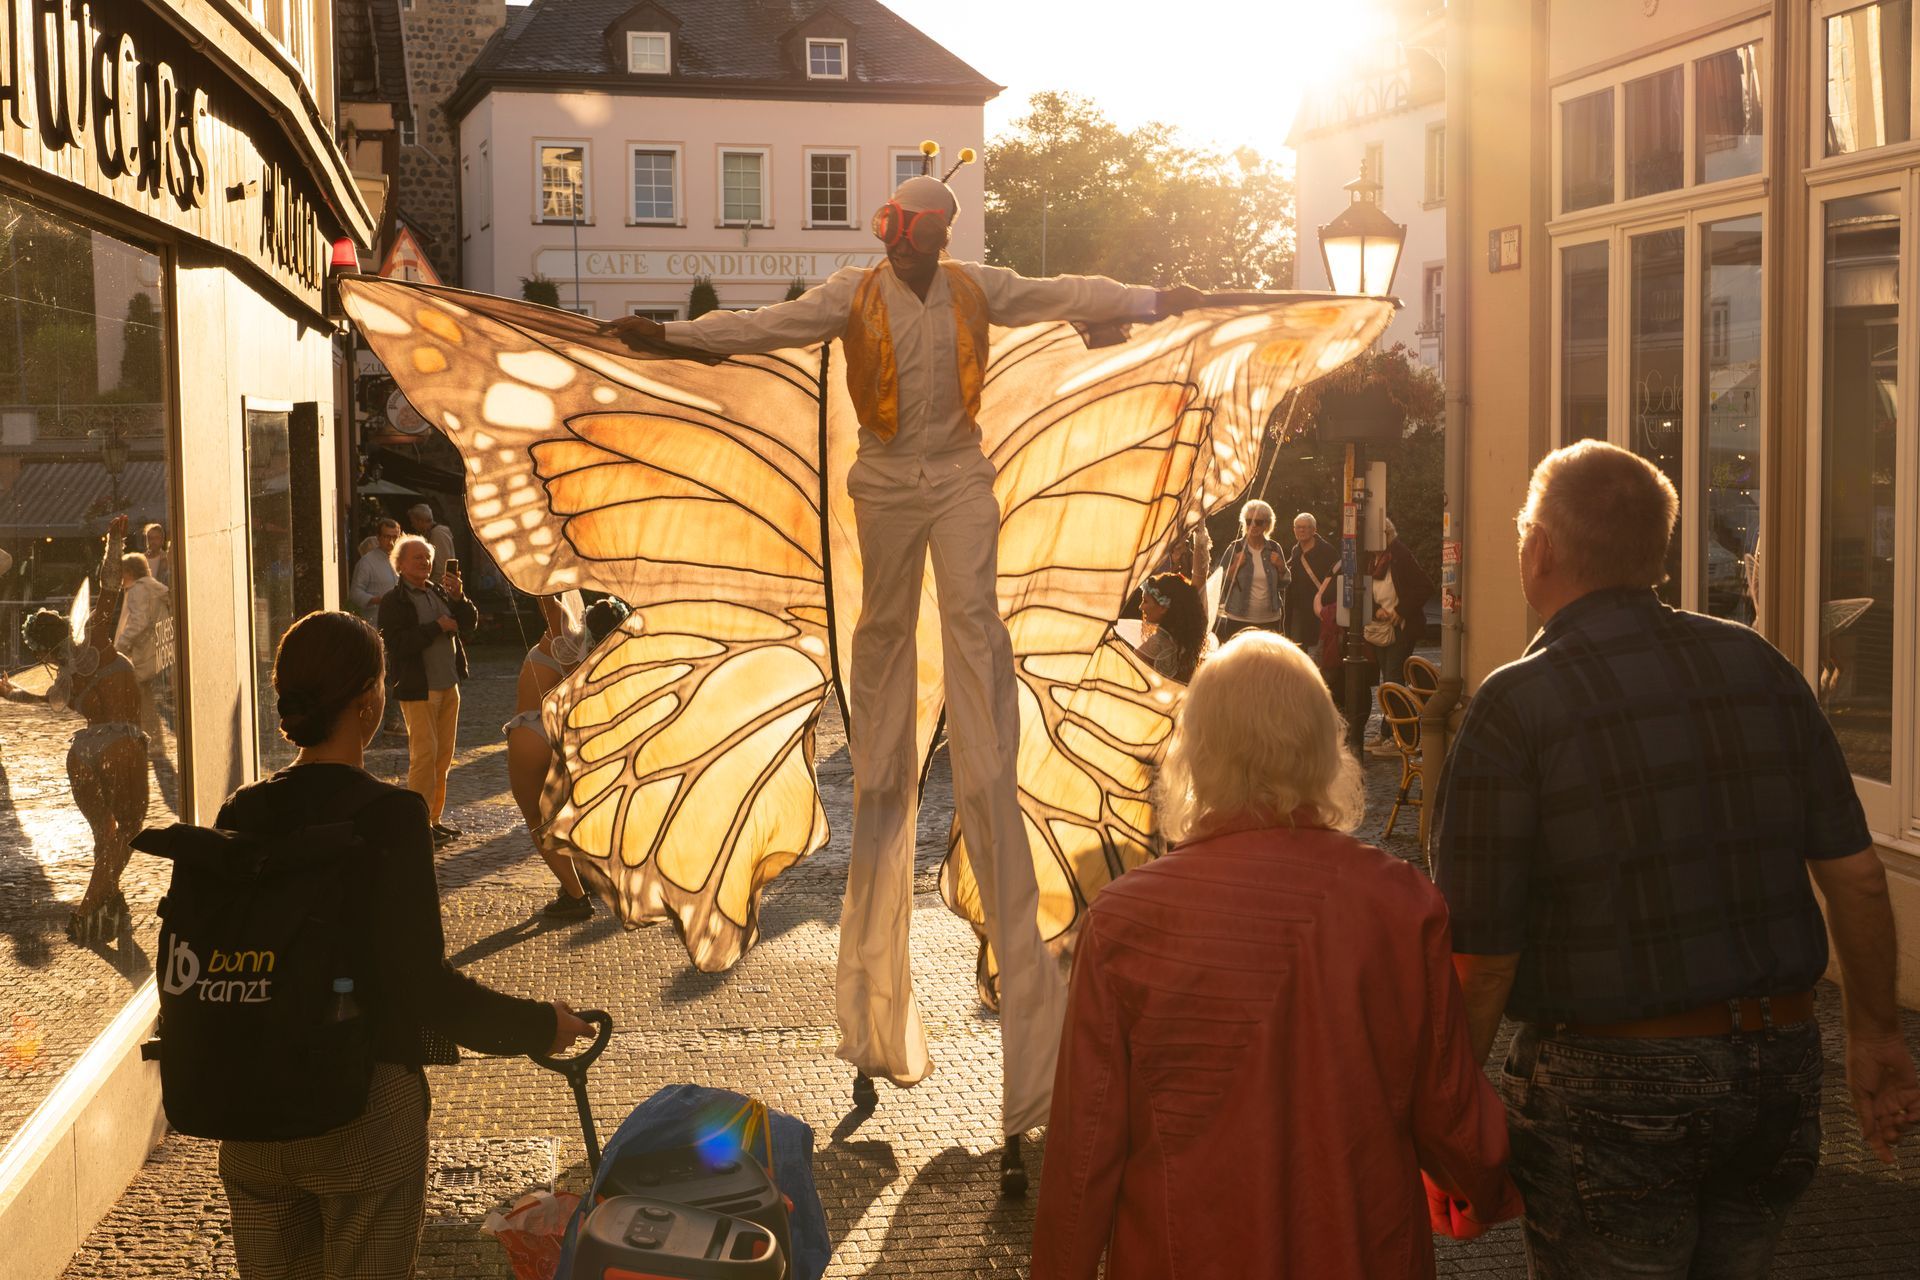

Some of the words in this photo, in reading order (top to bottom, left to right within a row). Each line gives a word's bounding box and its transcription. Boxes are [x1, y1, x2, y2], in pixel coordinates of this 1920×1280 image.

[586, 253, 649, 275] CAFE
[666, 253, 817, 276] CONDITOREI
[207, 950, 275, 972] bonn
[196, 977, 272, 1002] tanzt
